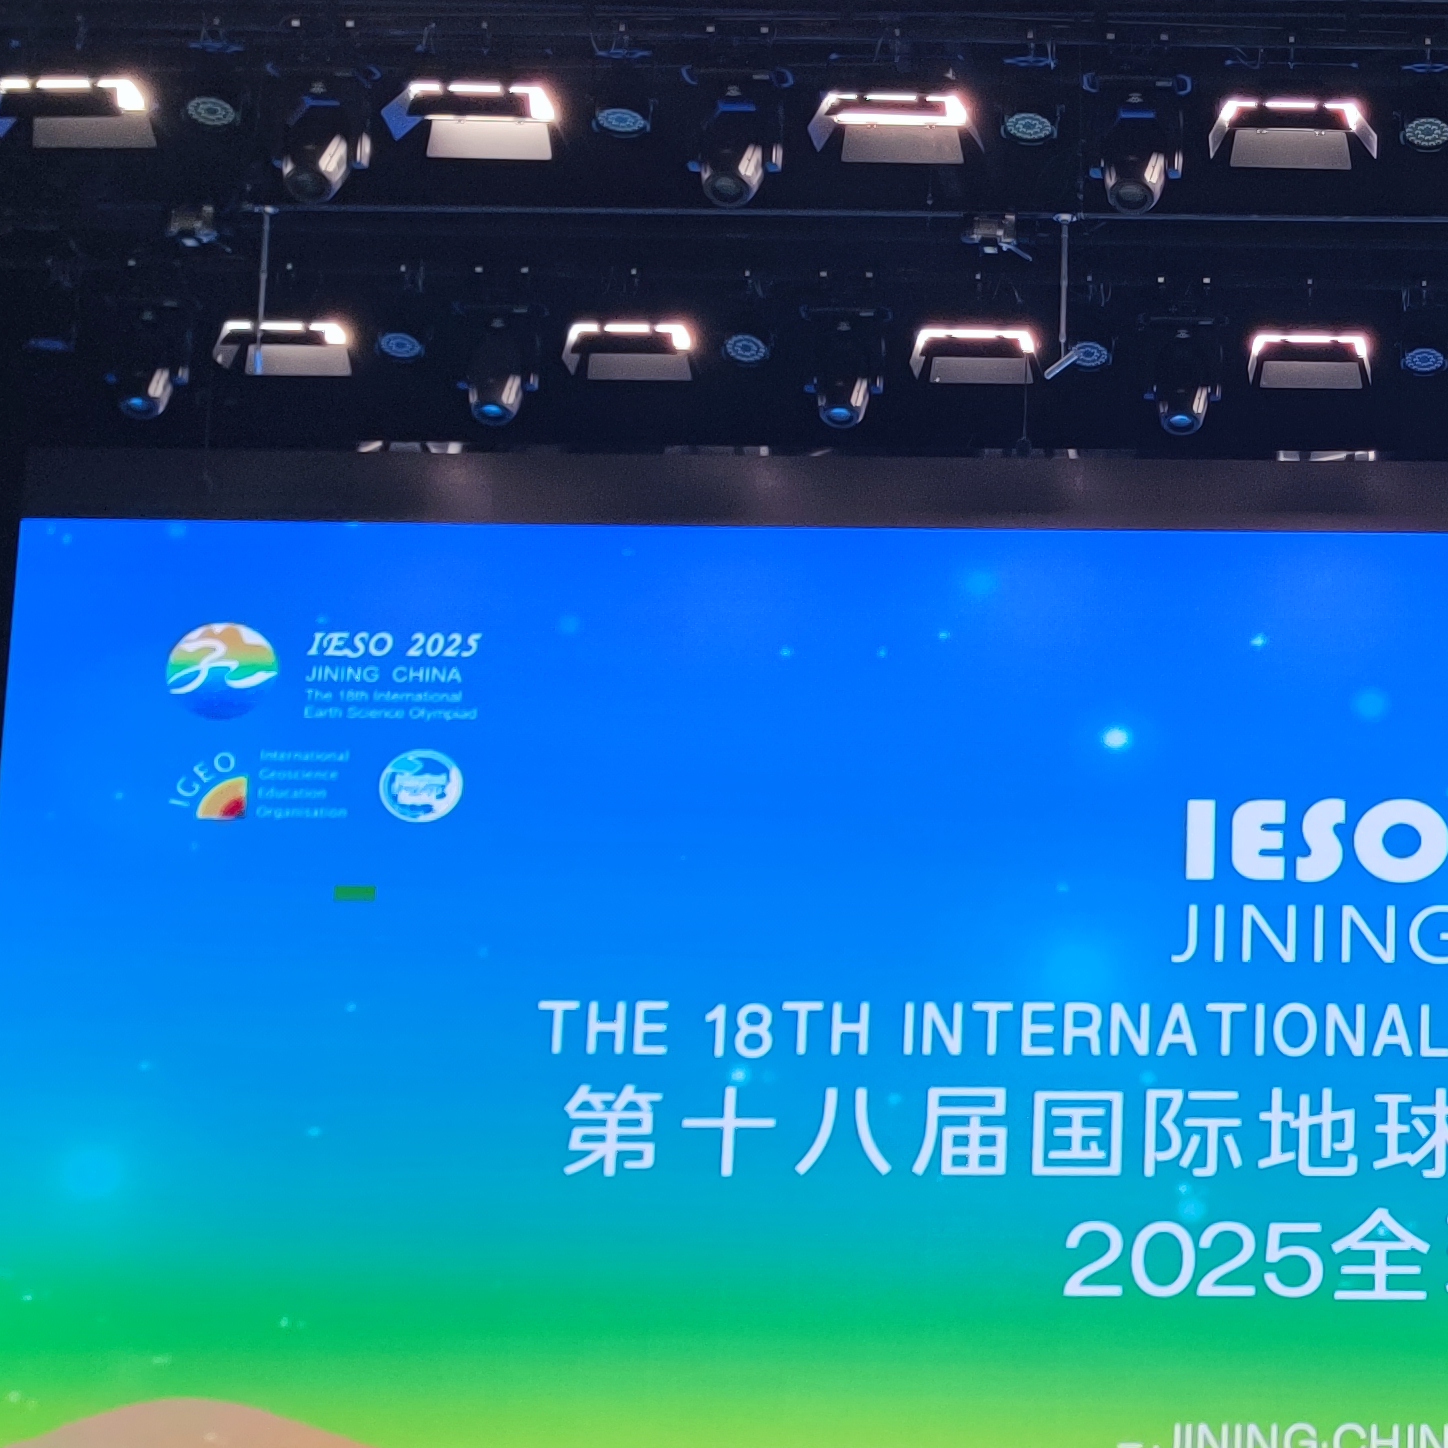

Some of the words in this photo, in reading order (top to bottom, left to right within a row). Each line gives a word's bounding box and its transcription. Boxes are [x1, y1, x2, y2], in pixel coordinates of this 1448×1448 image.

[306, 631, 394, 658] IESO
[405, 632, 482, 658] 2025
[305, 665, 380, 683] JINING
[392, 666, 463, 683] CHINA
[537, 1000, 669, 1056] THE
[705, 1001, 870, 1058] 18TH
